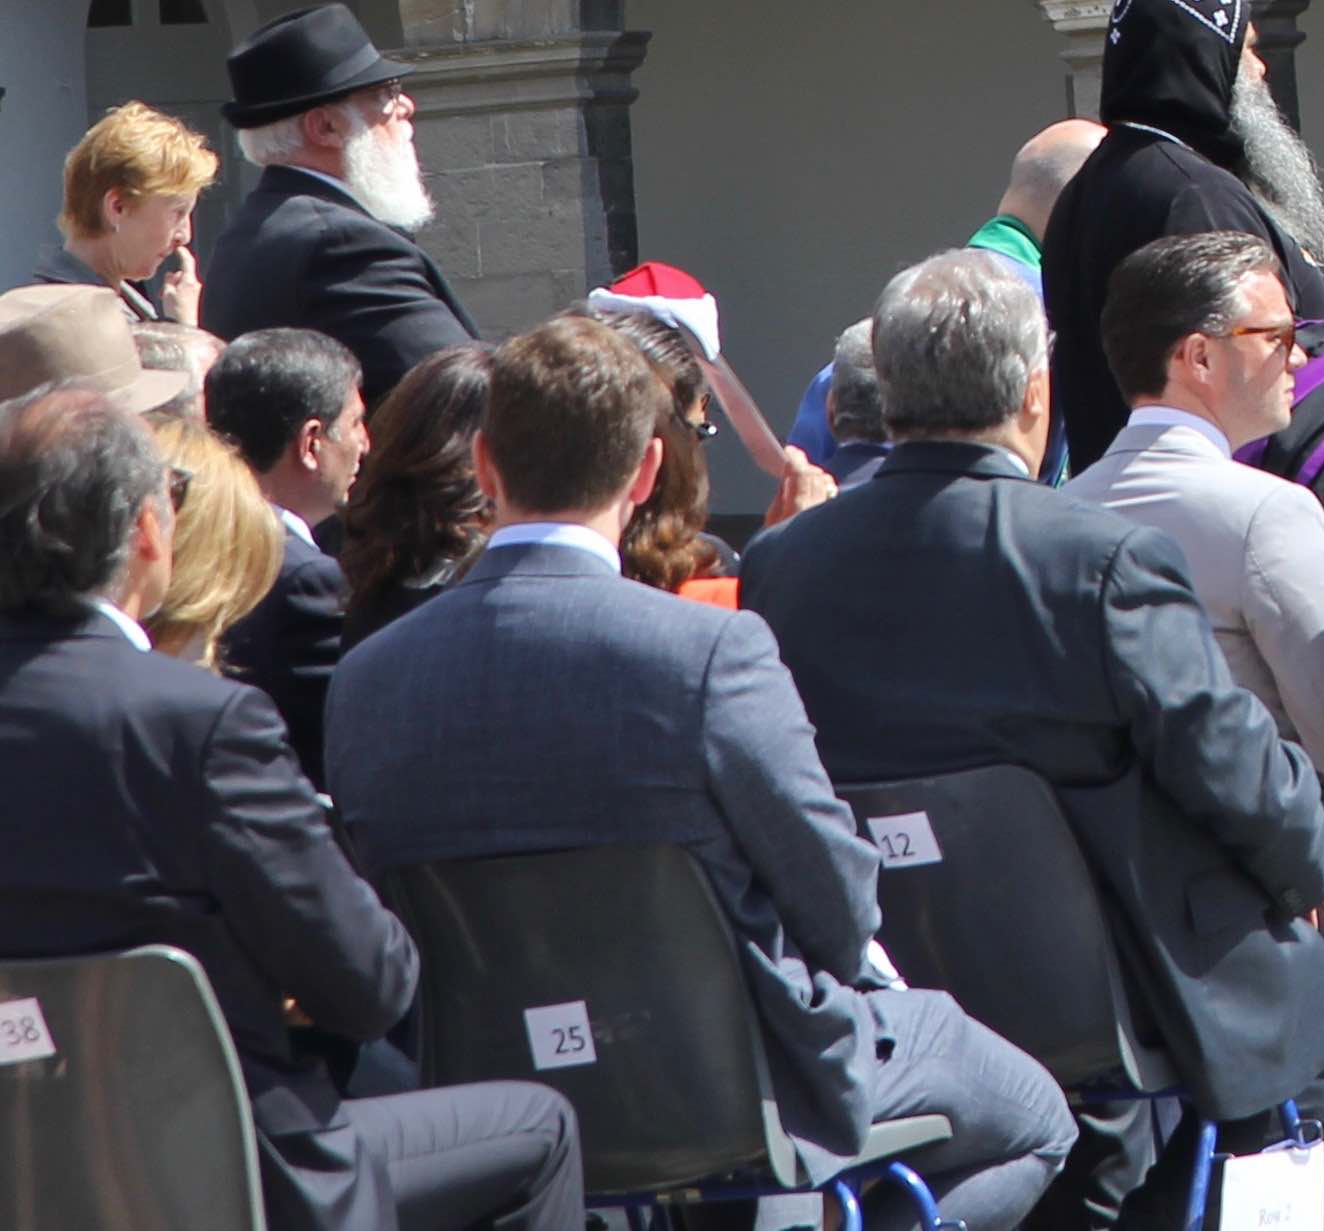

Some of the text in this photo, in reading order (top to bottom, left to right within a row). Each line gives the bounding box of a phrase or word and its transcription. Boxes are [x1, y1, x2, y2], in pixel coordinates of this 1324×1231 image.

[881, 832, 916, 858] 12
[1, 1016, 40, 1045] 38
[551, 1025, 586, 1055] 25
